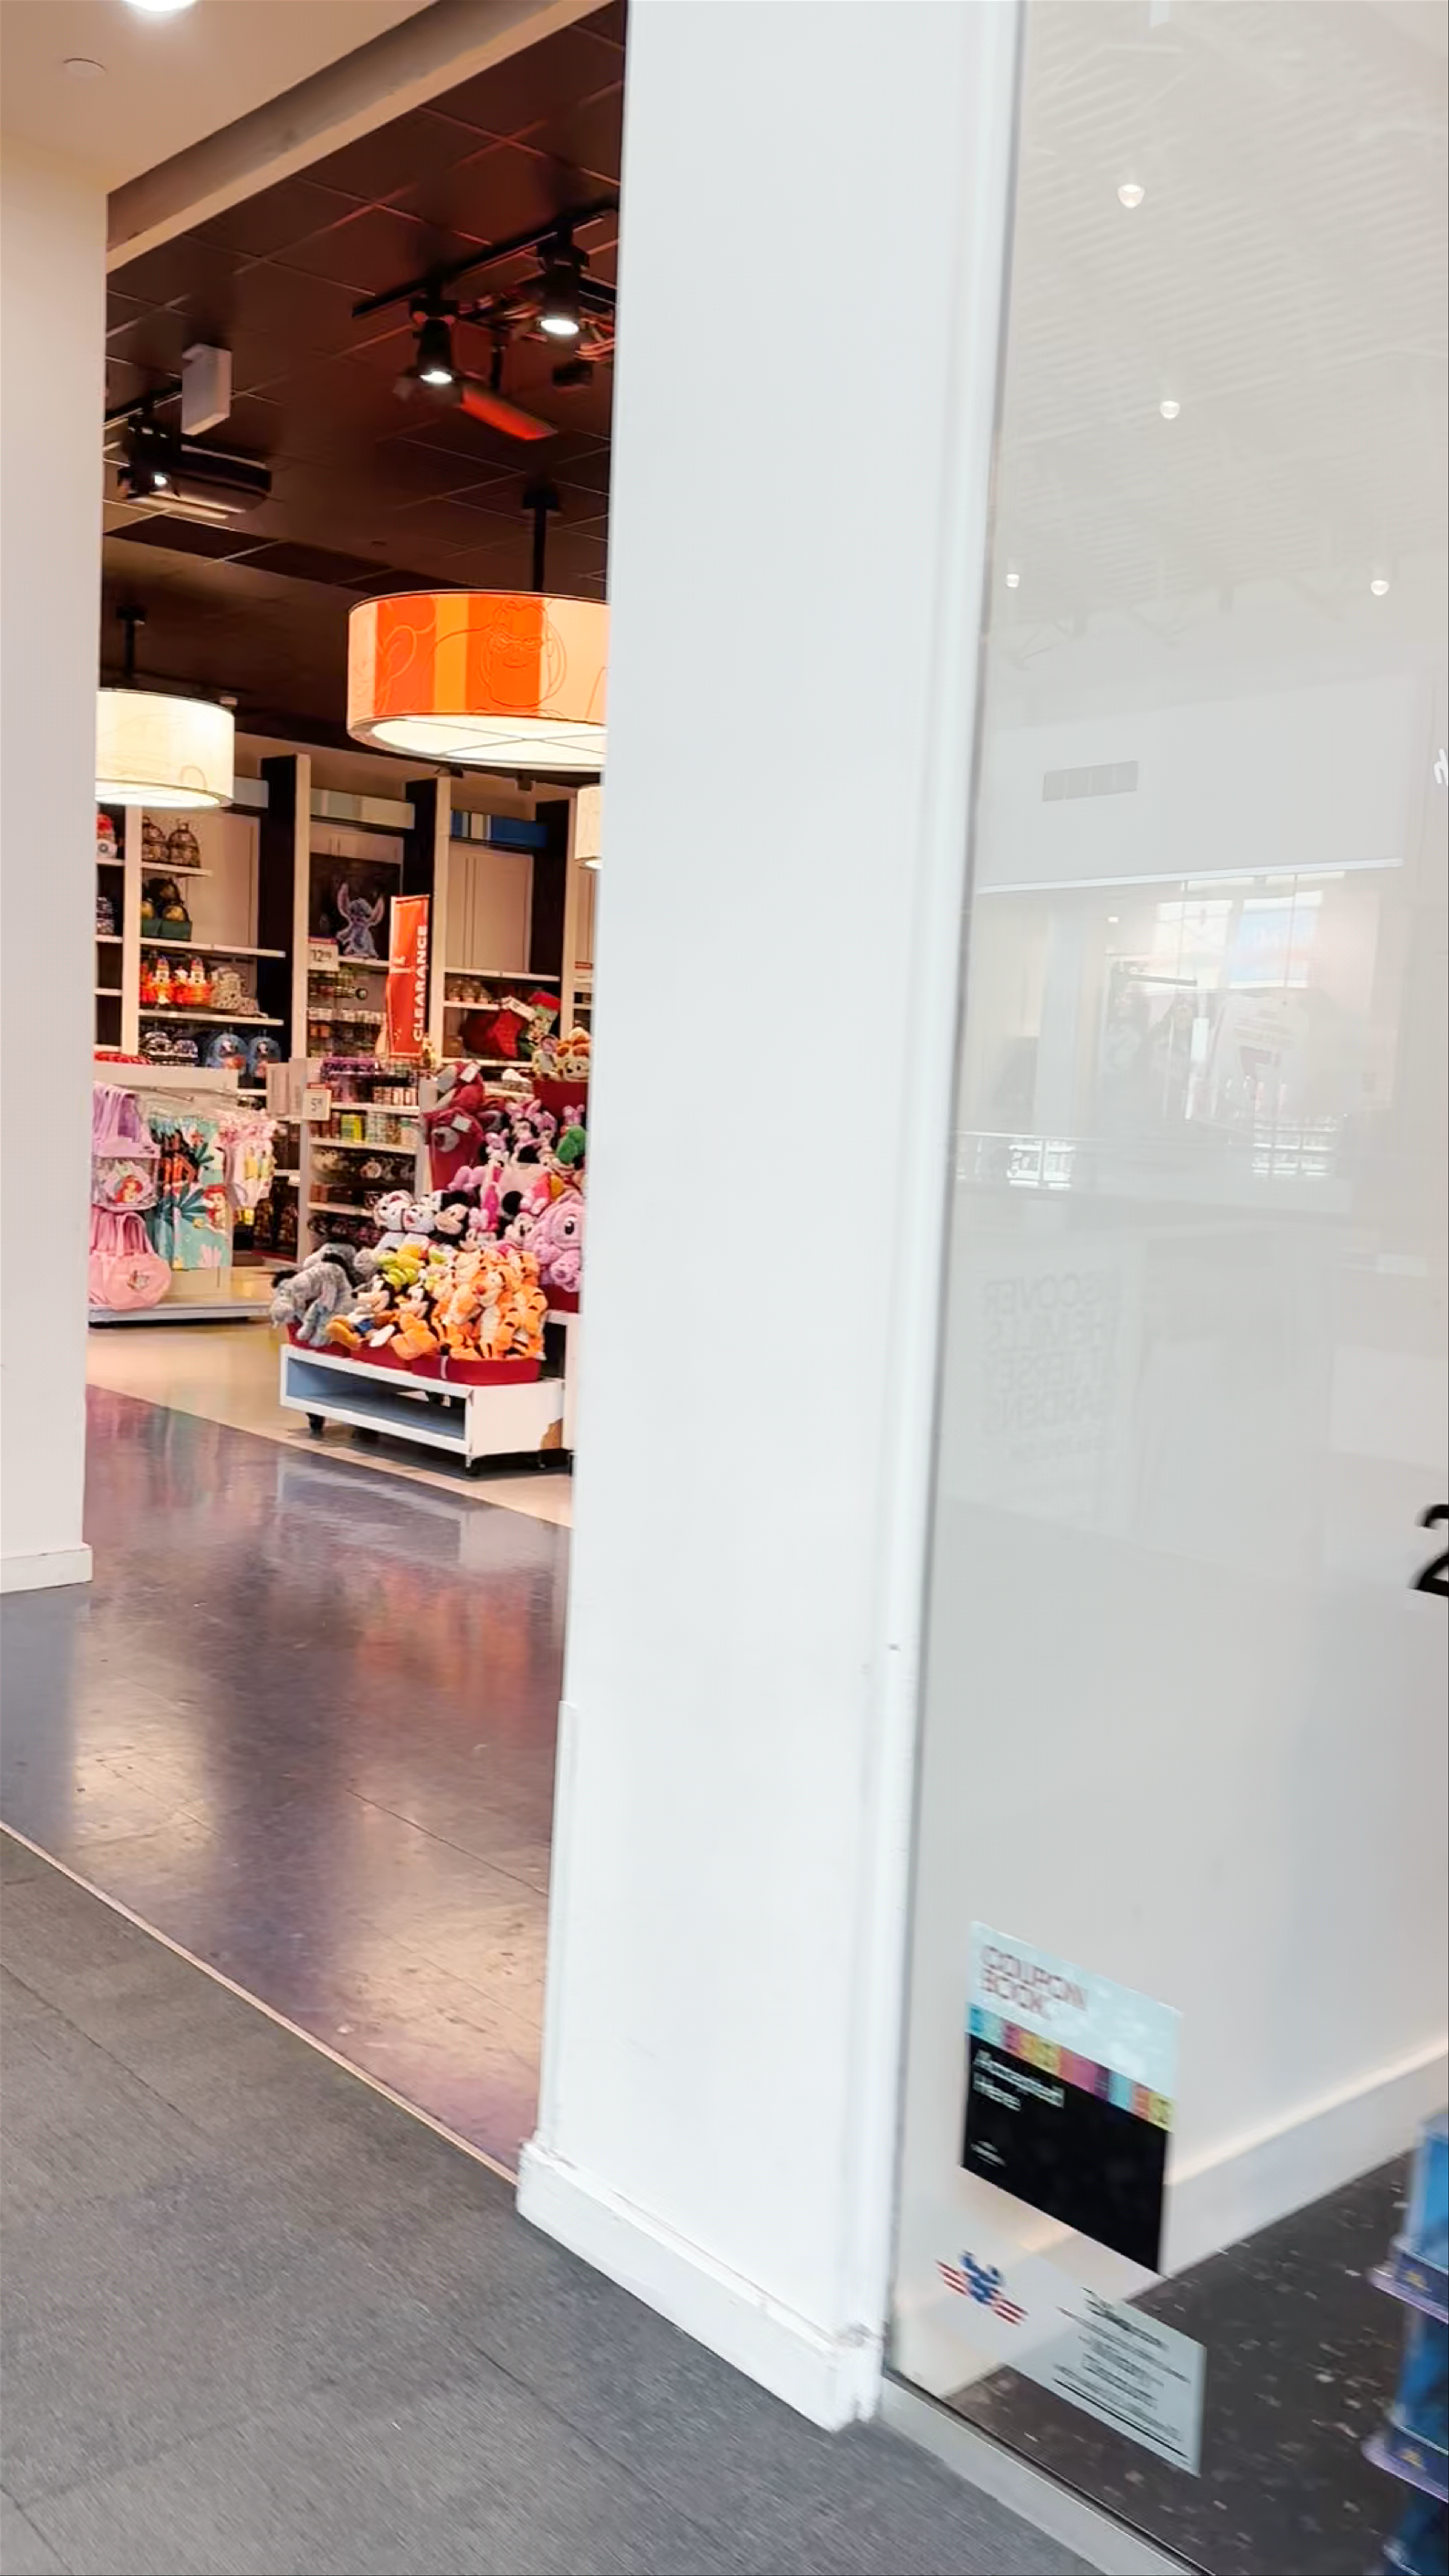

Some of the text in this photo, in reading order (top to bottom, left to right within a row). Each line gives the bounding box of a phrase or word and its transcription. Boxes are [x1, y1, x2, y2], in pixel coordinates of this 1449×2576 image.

[413, 925, 427, 1041] CLEARANCE
[981, 1968, 1051, 2020] BOOK
[982, 1945, 1087, 2011] COUPON
